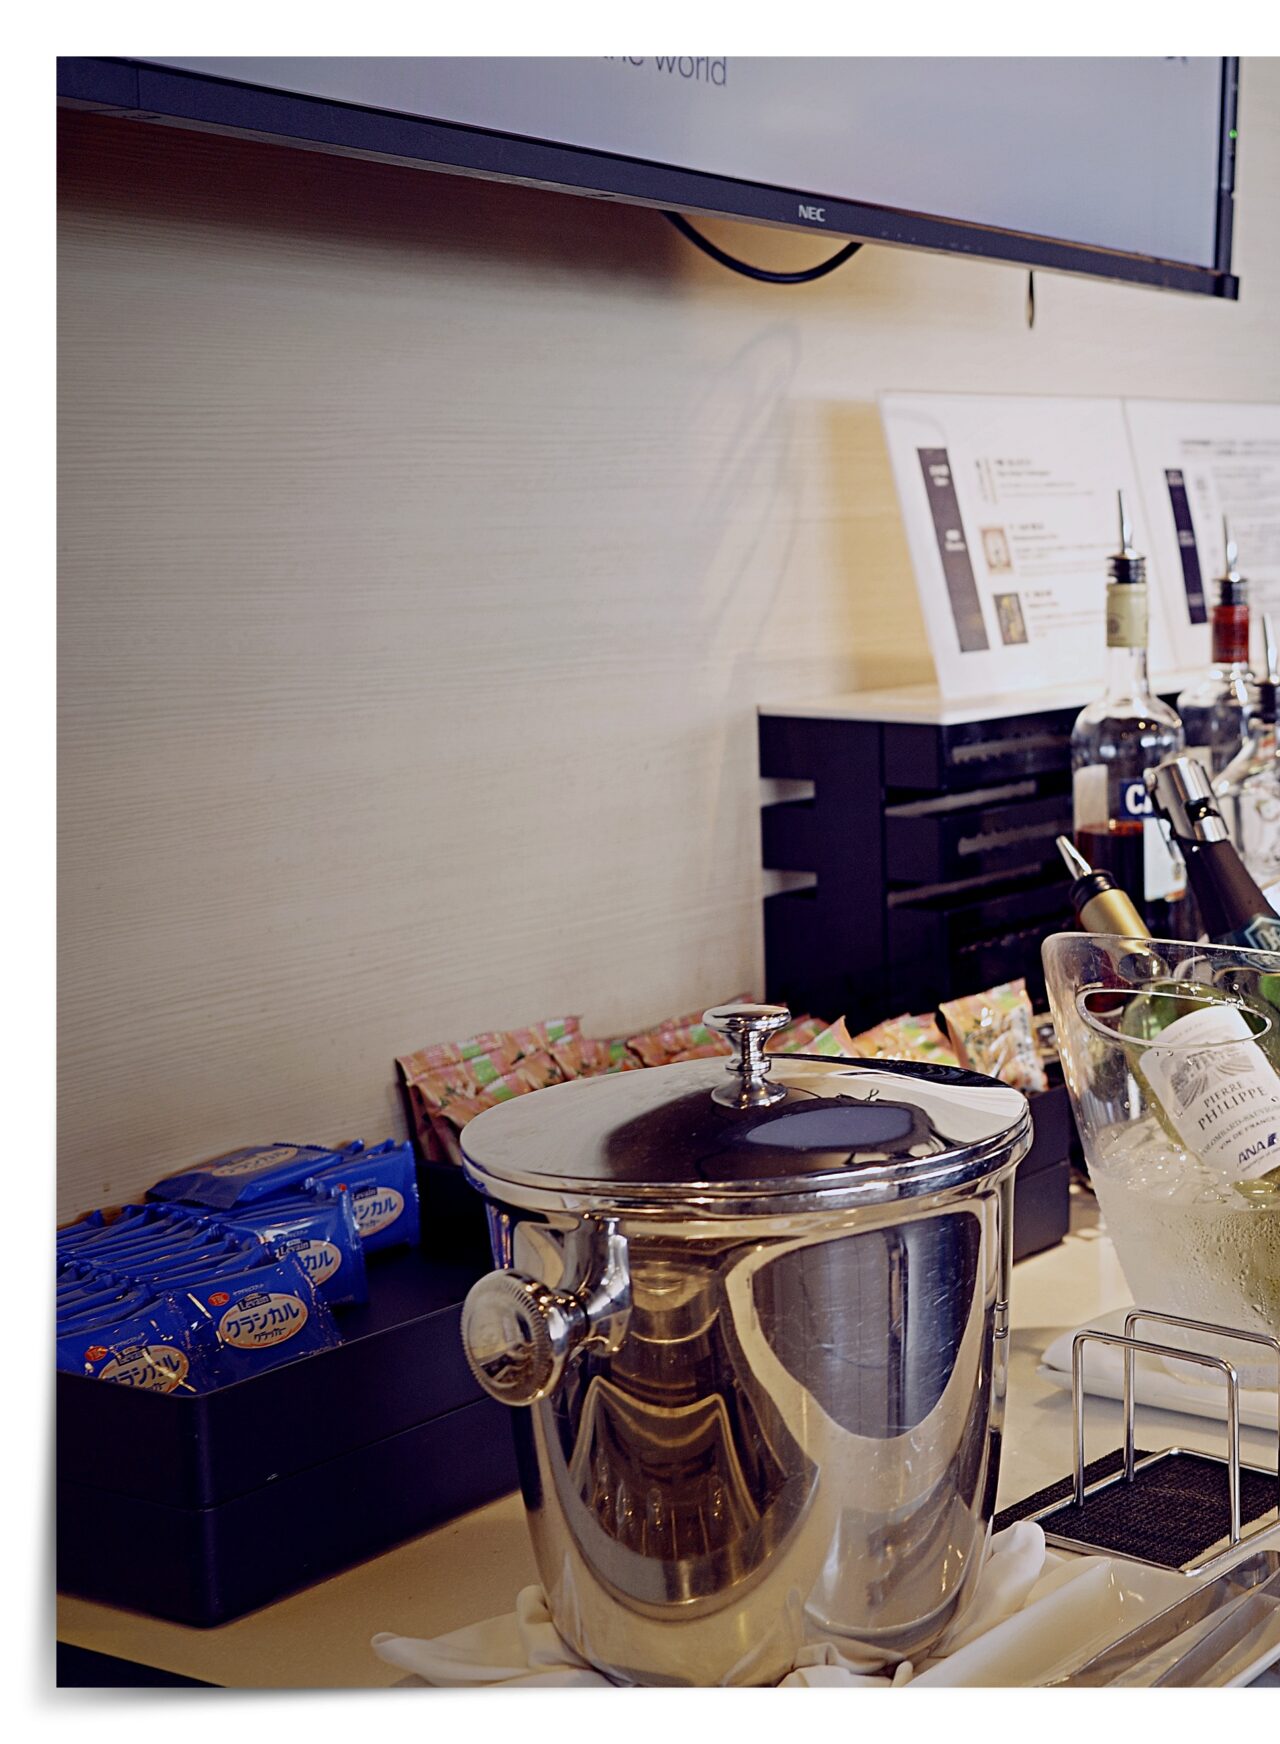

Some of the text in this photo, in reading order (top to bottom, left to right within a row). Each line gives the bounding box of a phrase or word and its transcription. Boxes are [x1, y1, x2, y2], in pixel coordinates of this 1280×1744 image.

[655, 56, 727, 87] world
[798, 204, 826, 222] NEC
[1203, 1081, 1243, 1108] PIERRE
[1198, 1086, 1267, 1131] PHILIPPE
[1237, 1140, 1266, 1164] ANA
[354, 1196, 398, 1220] シカル
[226, 1302, 300, 1338] クラシカル
